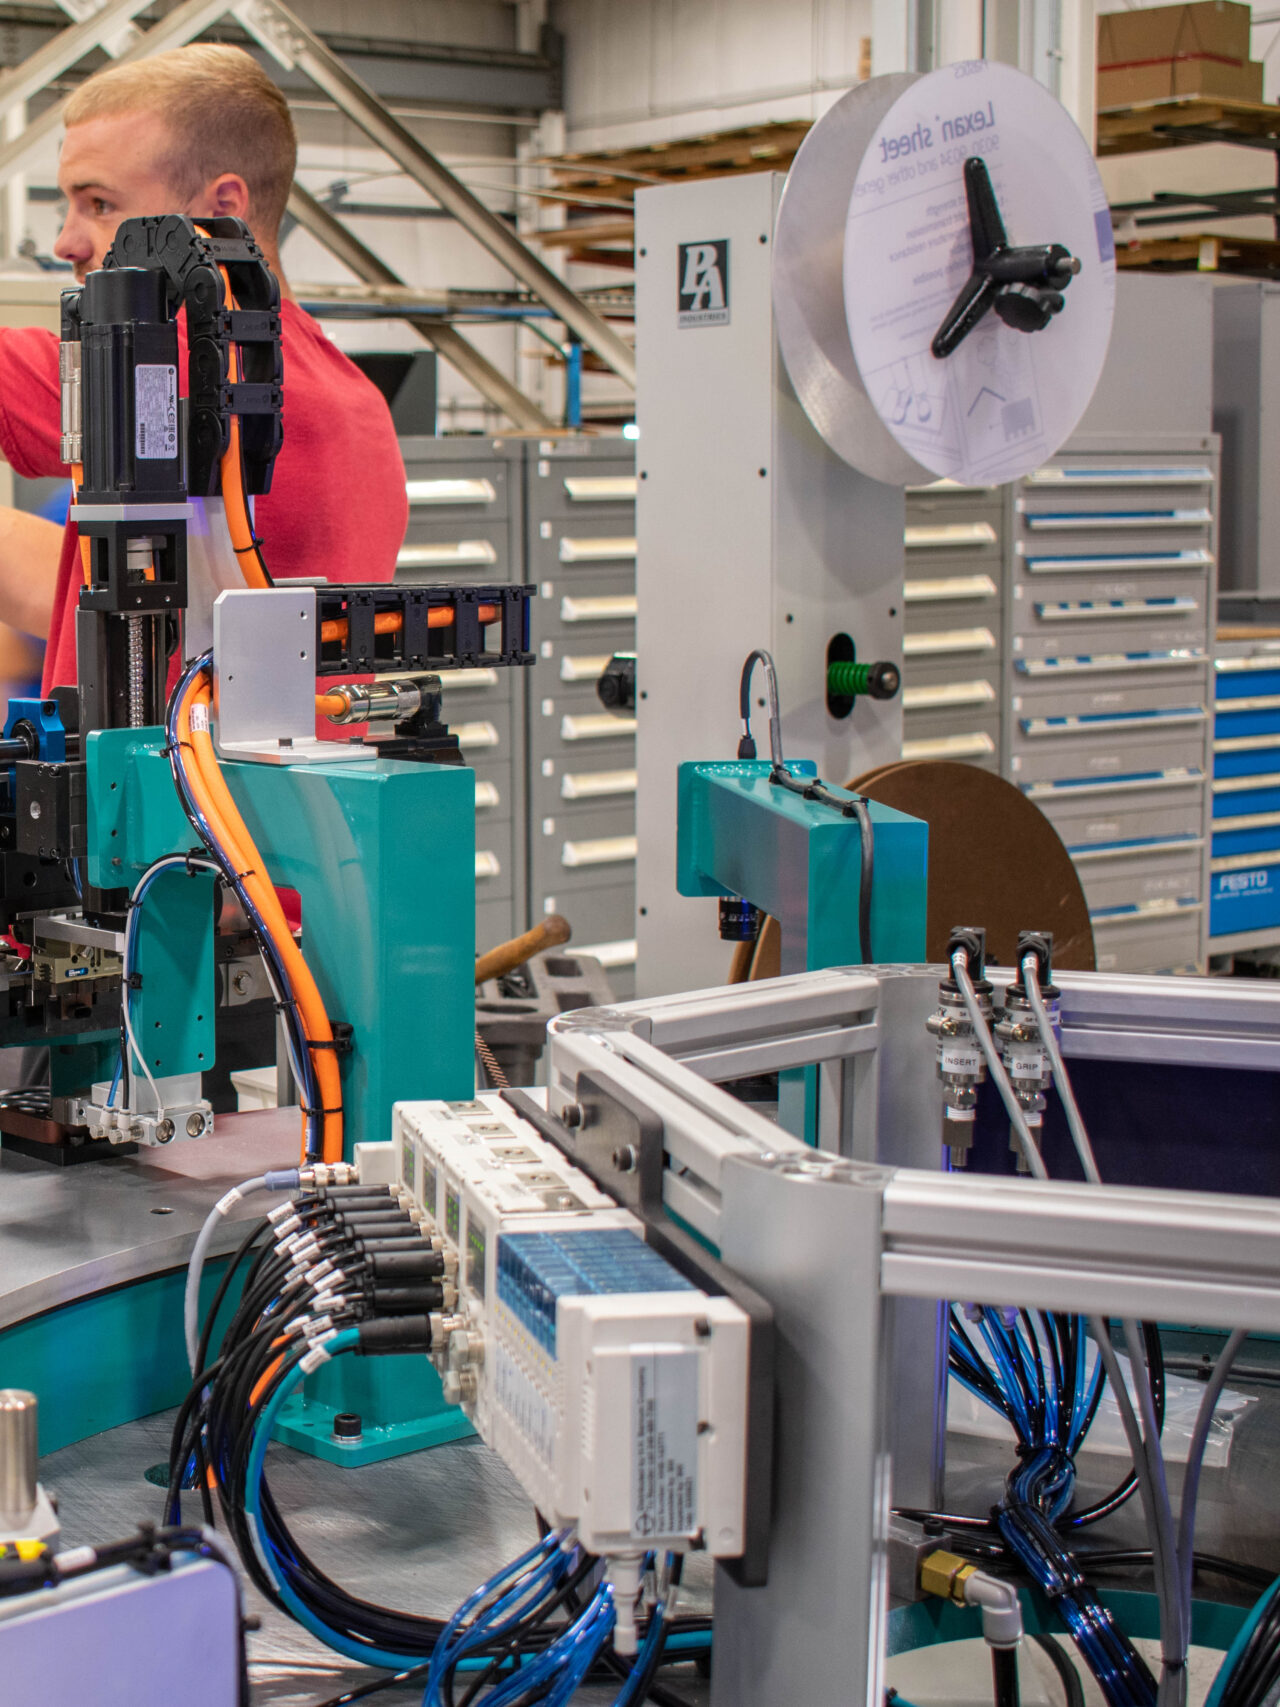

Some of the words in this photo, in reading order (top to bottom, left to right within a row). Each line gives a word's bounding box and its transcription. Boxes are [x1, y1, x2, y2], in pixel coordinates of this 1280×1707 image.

[1219, 870, 1268, 891] FESTO
[945, 1055, 977, 1067] INSERT
[1016, 1062, 1039, 1071] GRIP
